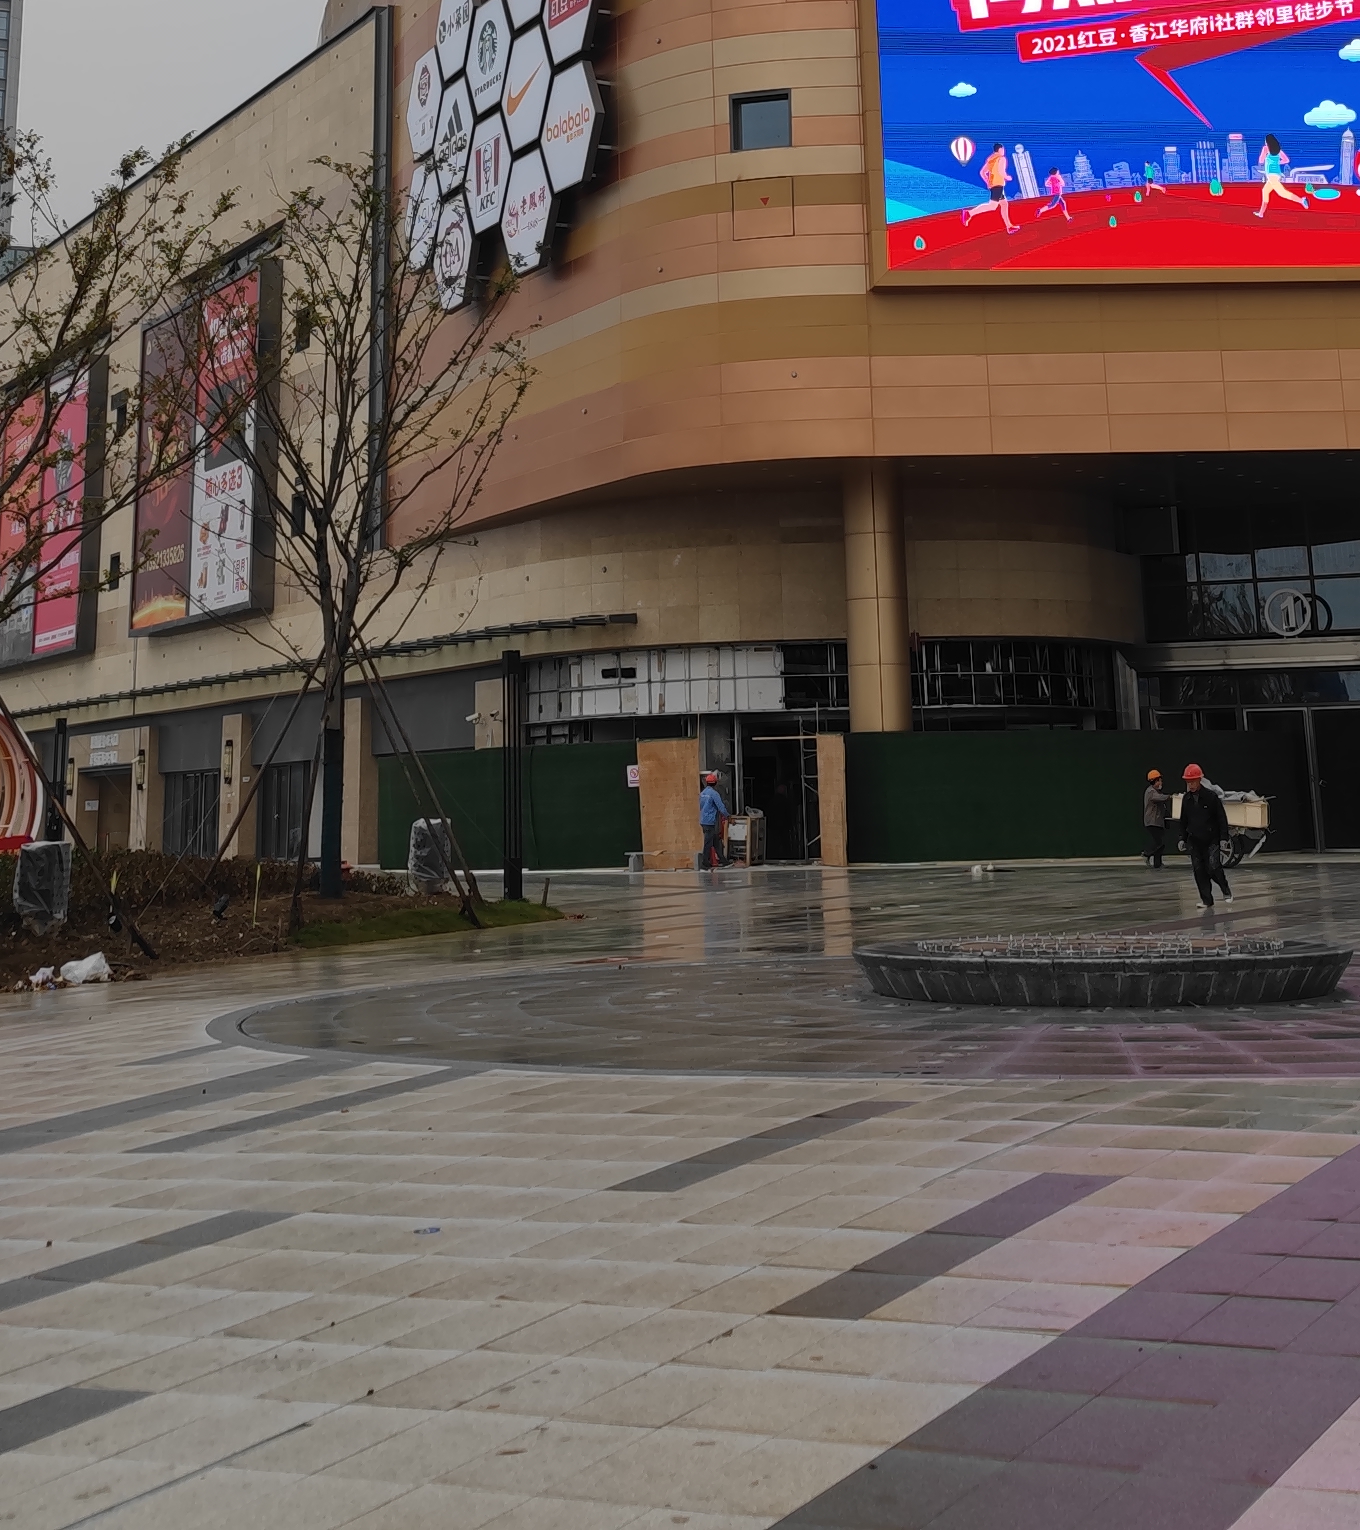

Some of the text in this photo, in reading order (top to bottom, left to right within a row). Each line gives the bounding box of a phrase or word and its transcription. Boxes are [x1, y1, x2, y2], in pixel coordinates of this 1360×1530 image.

[447, 0, 470, 37] 小菜园
[474, 72, 502, 98] STARBUCKS
[546, 103, 590, 142] balabala
[479, 191, 496, 212] KFC
